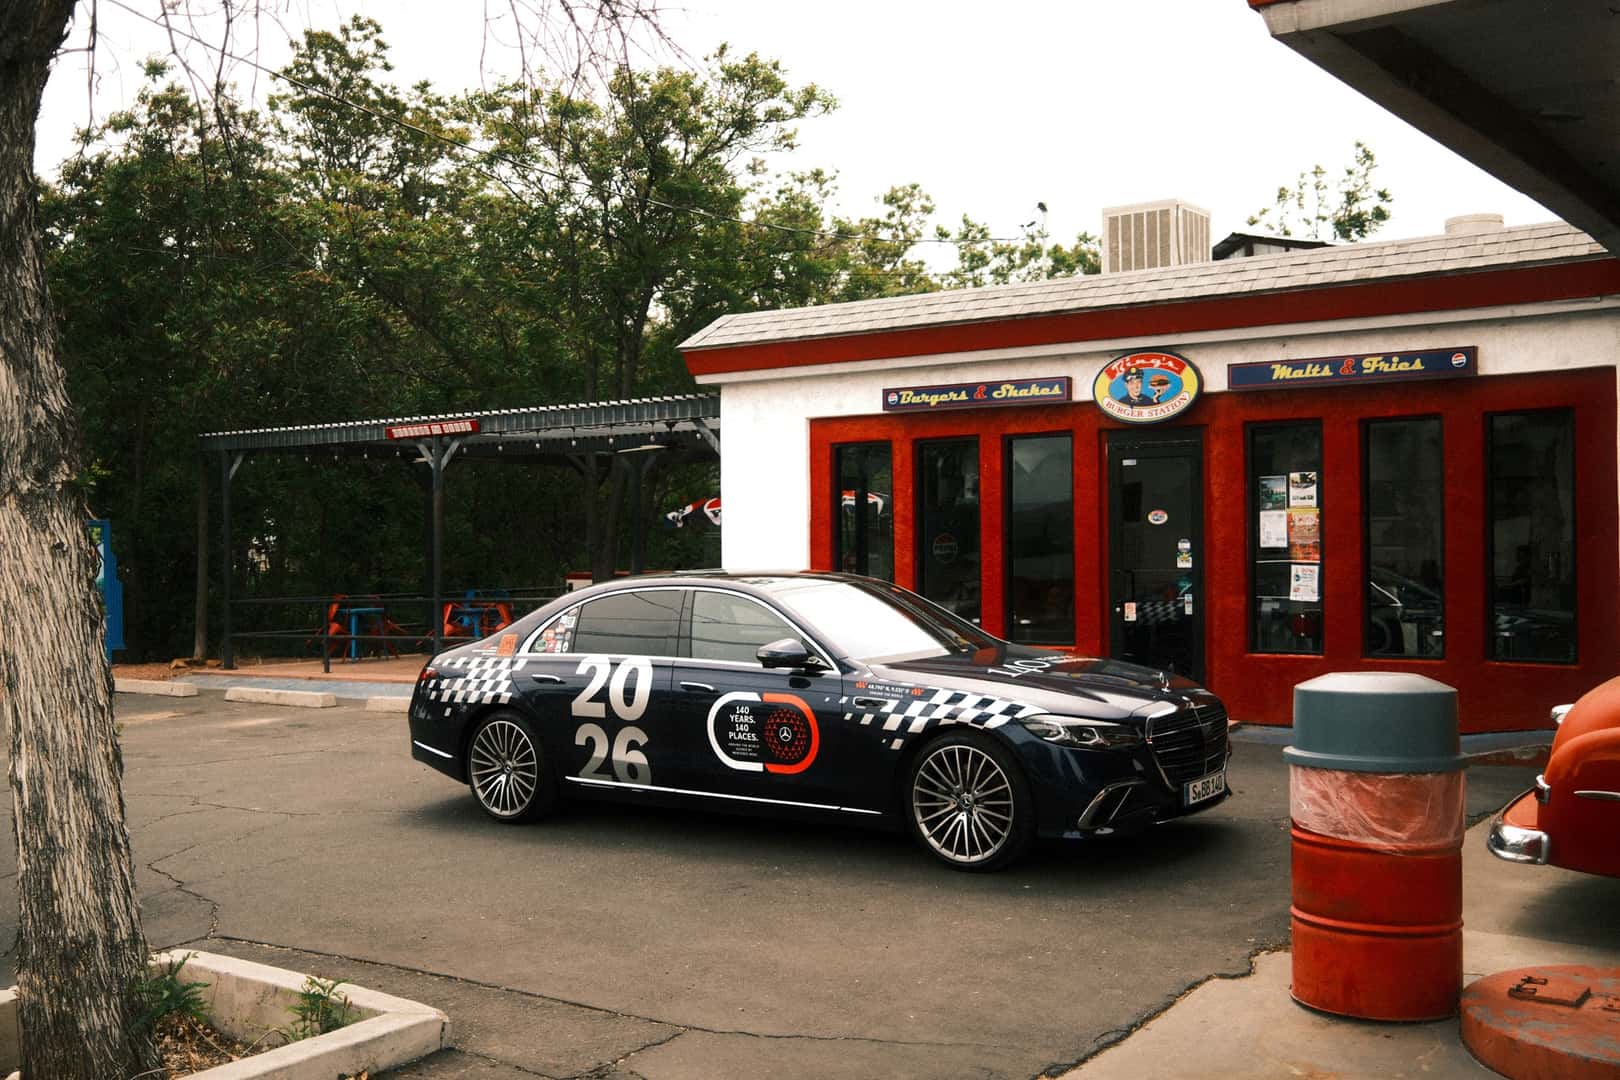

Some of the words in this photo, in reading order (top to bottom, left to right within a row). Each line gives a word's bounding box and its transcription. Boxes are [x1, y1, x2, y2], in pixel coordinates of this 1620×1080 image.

[1271, 364, 1333, 379] Malts
[1339, 359, 1356, 375] &
[1362, 356, 1424, 373] Fries
[900, 391, 968, 406] Burgers
[974, 385, 987, 399] &
[992, 384, 1062, 398] Shakes
[1105, 400, 1144, 417] BURGER
[1147, 393, 1187, 417] STATION
[987, 659, 1050, 678] 140
[571, 656, 653, 720] 20
[729, 715, 756, 724] YEARS.
[736, 706, 749, 714] 140
[728, 731, 759, 741] PLACES.
[575, 723, 652, 785] 26
